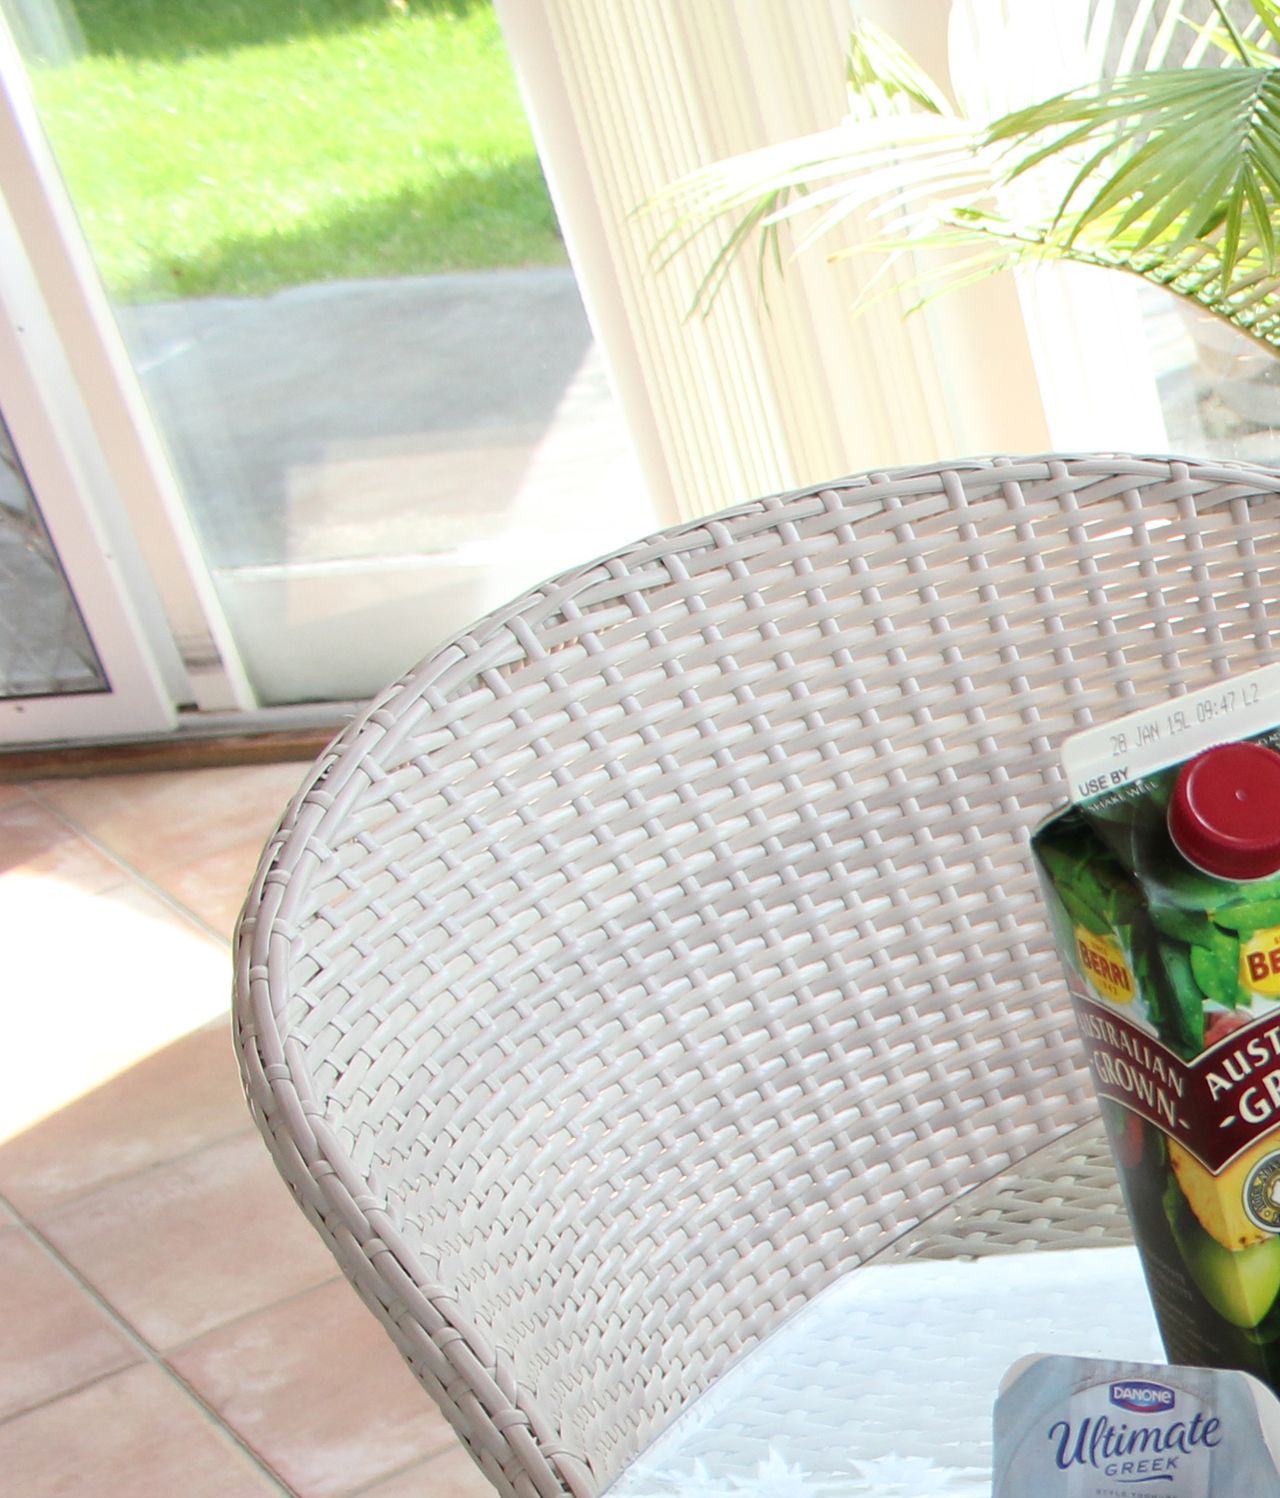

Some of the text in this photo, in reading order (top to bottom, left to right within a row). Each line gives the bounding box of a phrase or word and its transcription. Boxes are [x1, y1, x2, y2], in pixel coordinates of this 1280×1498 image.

[1136, 723, 1160, 748] JAN
[1078, 767, 1130, 797] USE BY
[1077, 939, 1132, 992] BERRI
[1048, 1411, 1223, 1470] Ultimate
[1104, 1456, 1180, 1477] GREEK
